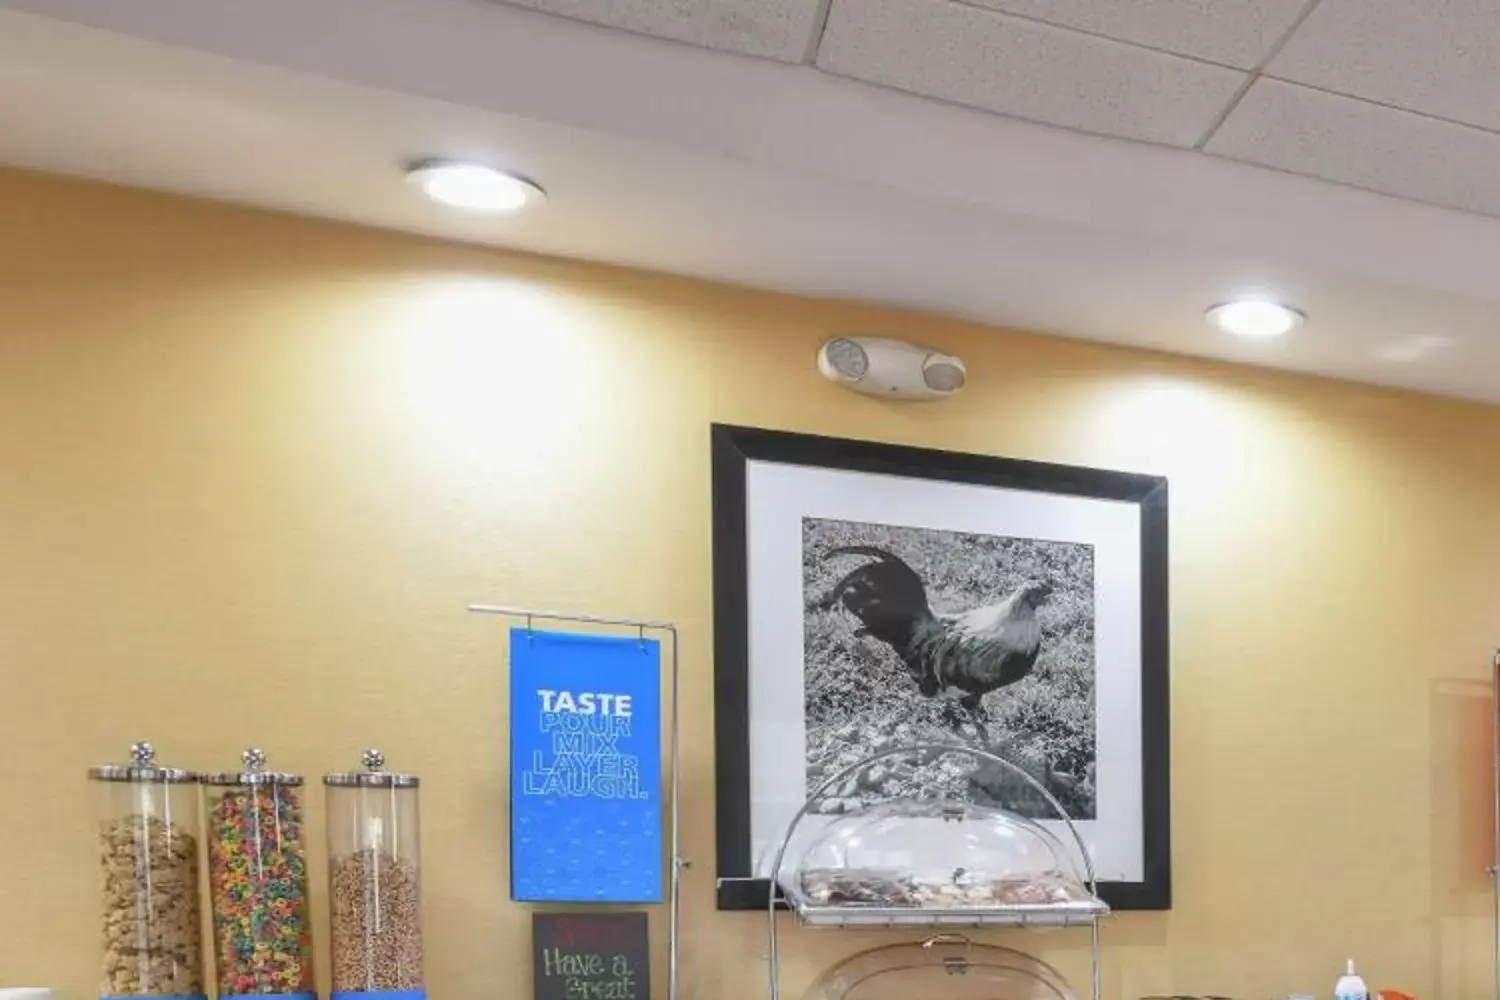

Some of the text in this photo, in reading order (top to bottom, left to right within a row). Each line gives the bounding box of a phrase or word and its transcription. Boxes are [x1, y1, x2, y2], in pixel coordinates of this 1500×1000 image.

[537, 690, 632, 717] TASTE
[540, 712, 632, 736] POUR
[553, 733, 618, 755] MIX
[533, 750, 639, 777] LAYER
[523, 772, 648, 799] LAUGH.
[543, 947, 635, 976] Have a
